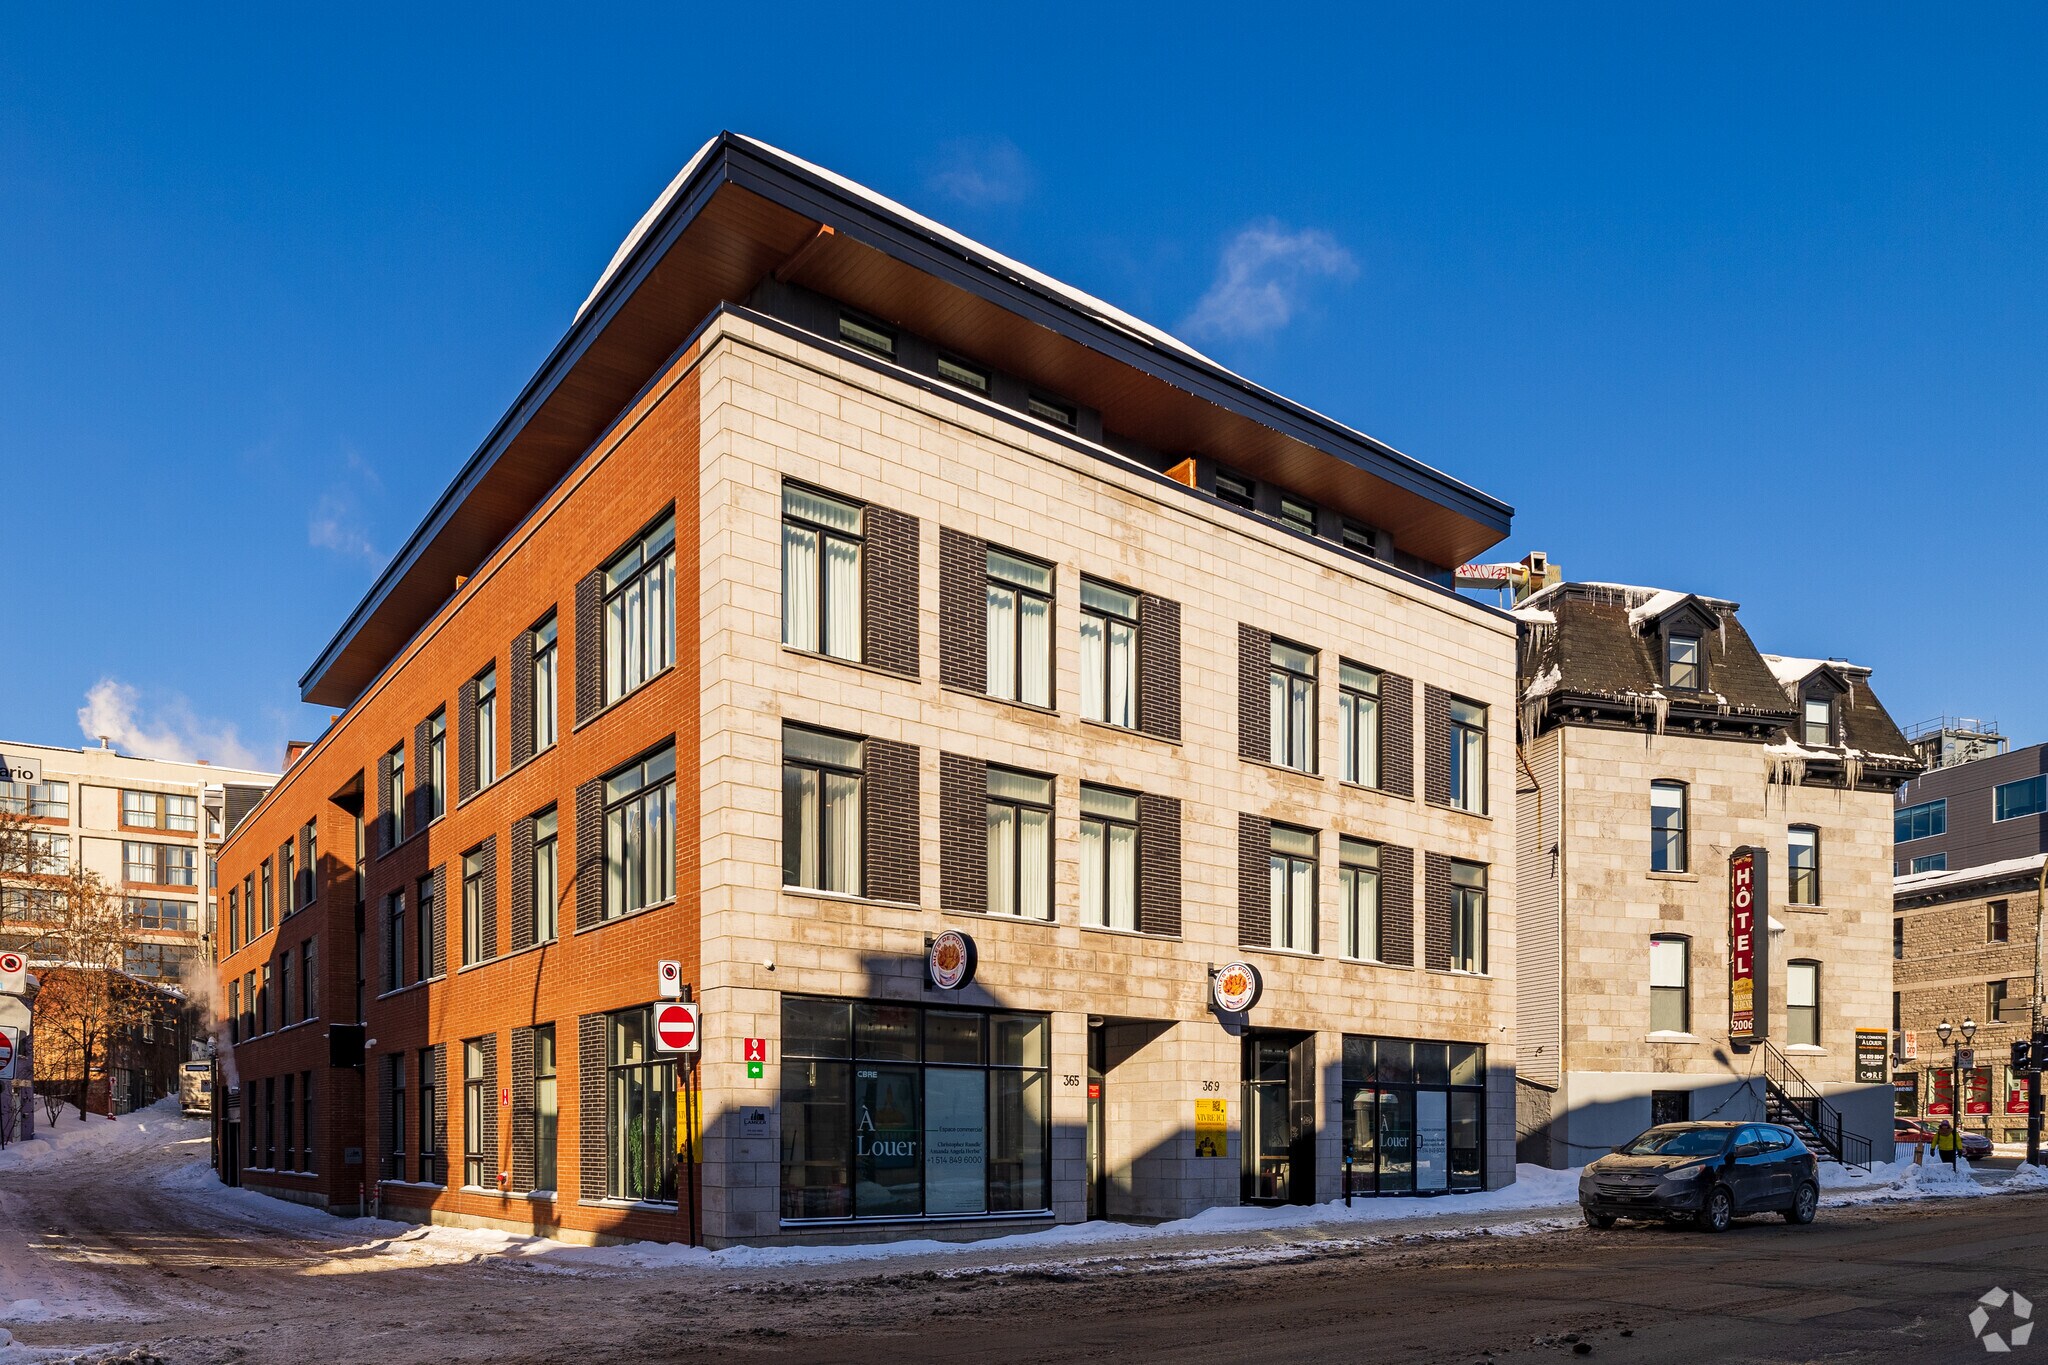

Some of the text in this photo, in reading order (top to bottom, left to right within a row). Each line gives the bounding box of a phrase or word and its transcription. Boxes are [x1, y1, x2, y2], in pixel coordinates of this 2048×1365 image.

[1736, 867, 1750, 973] HÔTEL
[1733, 1020, 1753, 1031] 2006
[1063, 1075, 1080, 1086] 365
[1203, 1081, 1220, 1091] 369
[857, 1104, 876, 1131] À
[1380, 1114, 1389, 1131] À
[857, 1135, 917, 1156] Louer
[1380, 1133, 1409, 1147] Louer
[936, 1156, 948, 1164] 514
[949, 1156, 962, 1164] 849
[963, 1156, 982, 1164] 6000
